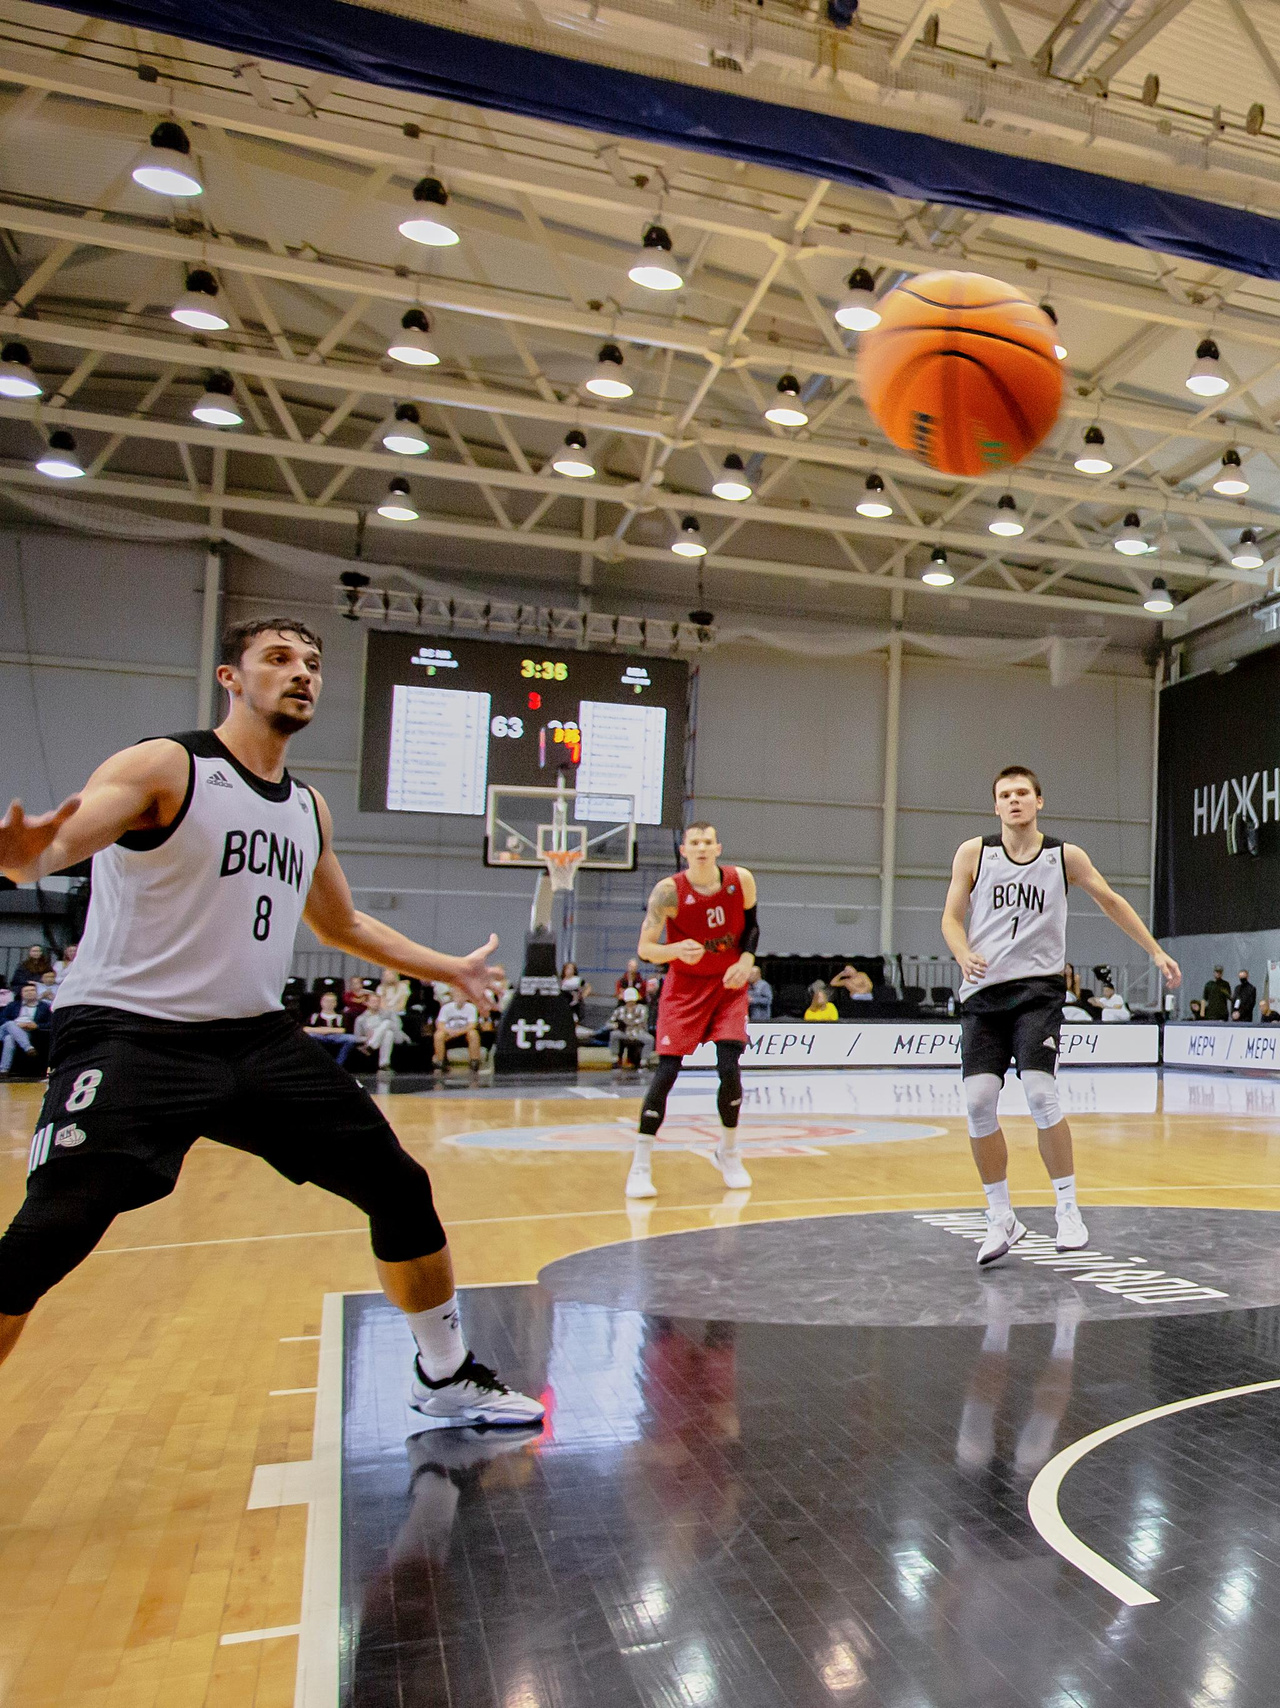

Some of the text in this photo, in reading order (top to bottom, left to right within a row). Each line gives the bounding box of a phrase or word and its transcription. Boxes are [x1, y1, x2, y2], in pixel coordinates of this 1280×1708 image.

[491, 715, 524, 739] 63
[220, 829, 304, 893] BCNN
[993, 882, 1045, 914] BCNN
[253, 895, 272, 941] 8
[706, 906, 726, 928] 20
[1011, 916, 1020, 940] 1
[892, 1034, 961, 1054] МЕРЧ
[1187, 1034, 1216, 1057] МЕРЧ
[1245, 1037, 1277, 1060] МЕРЧ
[66, 1069, 103, 1112] 8
